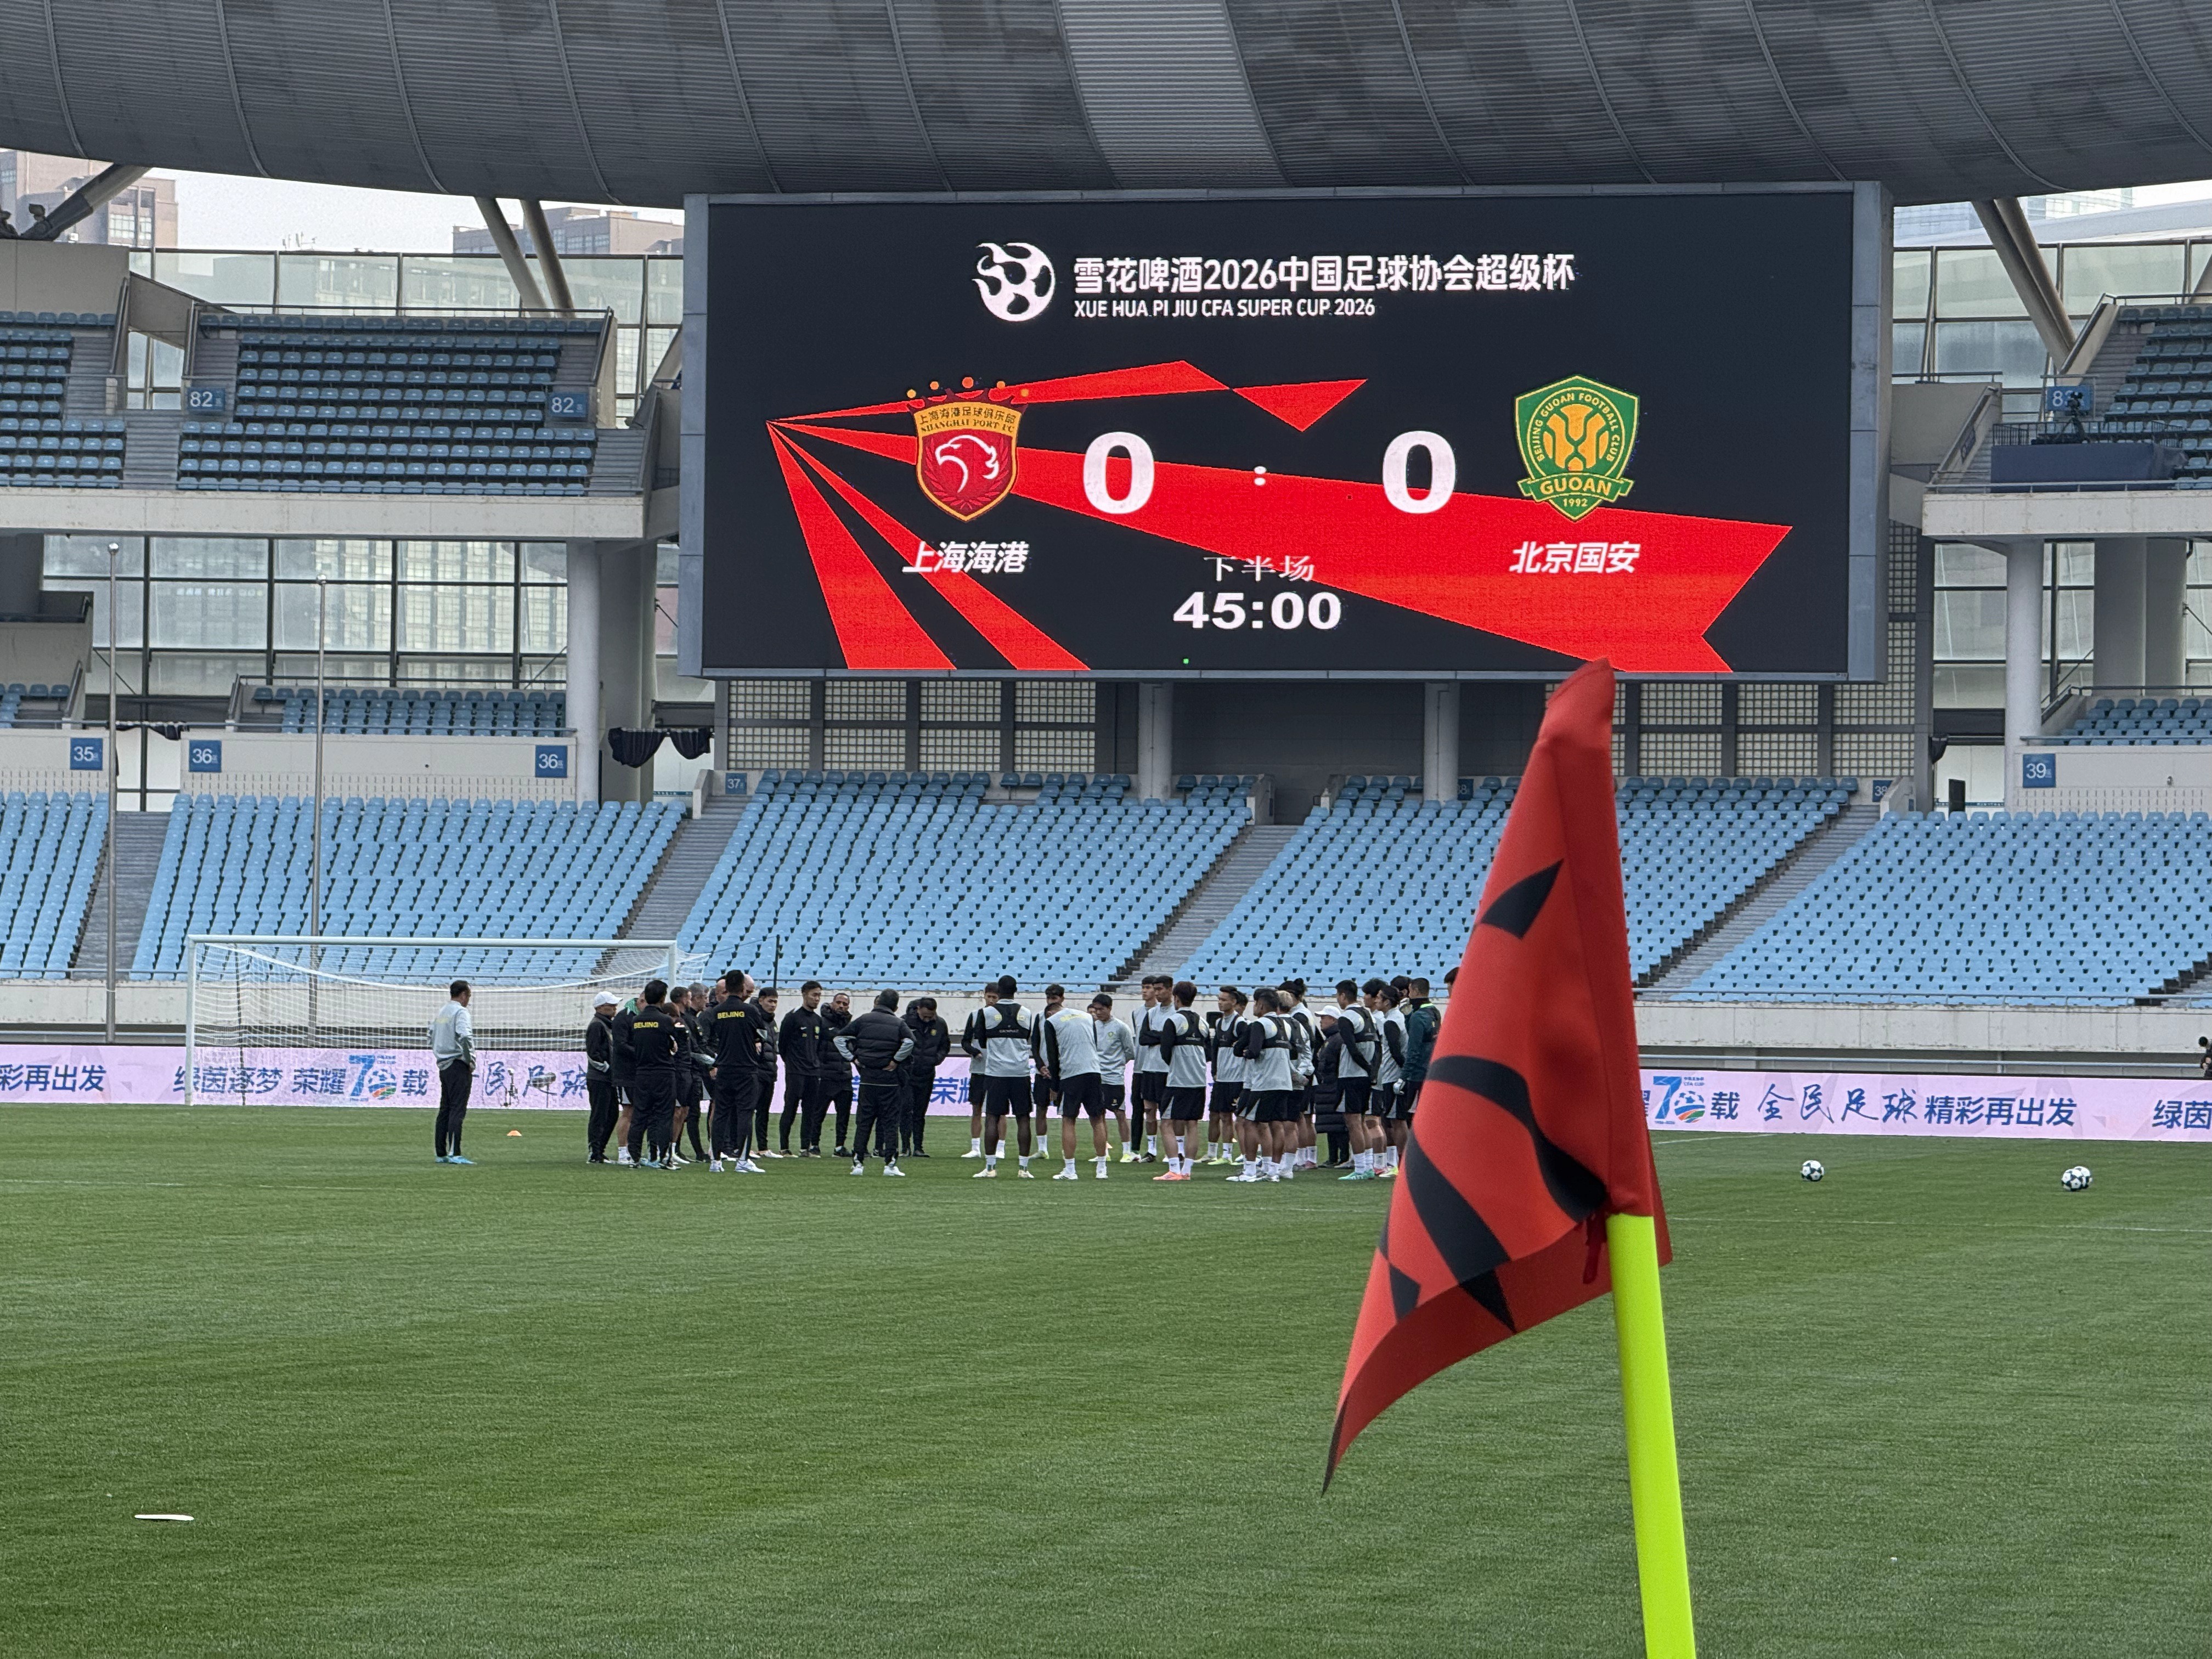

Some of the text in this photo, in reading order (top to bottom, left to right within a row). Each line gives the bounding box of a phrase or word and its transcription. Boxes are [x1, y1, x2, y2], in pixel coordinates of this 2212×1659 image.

[1074, 253, 1575, 293] 雪花啤酒2026中国足球协会超级杯
[1074, 298, 1375, 317] XUE HUA PI JIU CFA SUPER CUP 2026
[921, 419, 969, 432] SHANGHAI
[973, 419, 999, 429] PORT
[1532, 393, 1620, 462] BEIJING GUOAN FOOTBALL CLUB
[1083, 432, 1154, 514] 0
[1382, 431, 1457, 514] 0
[1540, 477, 1612, 495] GUOAN
[1563, 498, 1588, 507] 1992
[902, 541, 1029, 573] 上海海港
[1204, 555, 1314, 582] 下半场
[1509, 541, 1641, 573] 北京国安
[1173, 592, 1341, 629] 45:00
[717, 1011, 745, 1019] BEIJING
[173, 1065, 283, 1094] 绿茵逐梦
[1757, 1083, 1918, 1124] 全民足球
[1924, 1095, 2077, 1126] 精彩再出发
[2152, 1099, 2212, 1130] 绿茵
